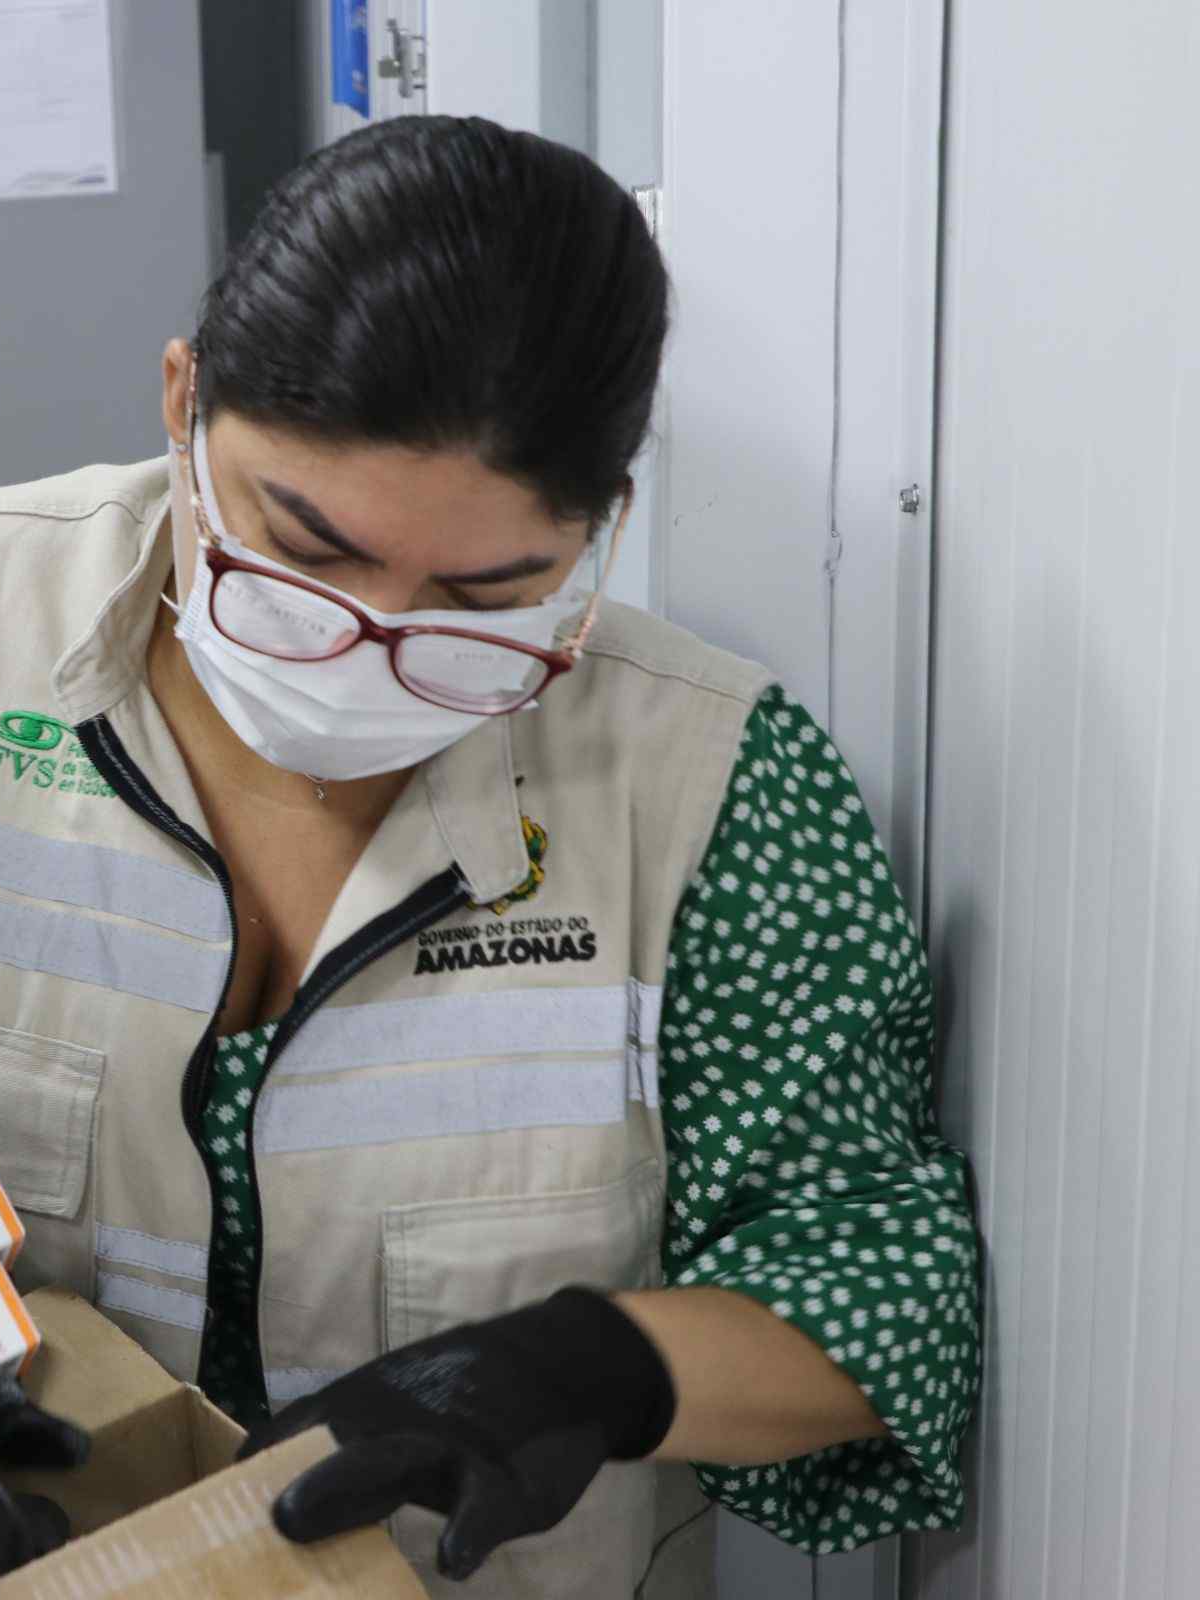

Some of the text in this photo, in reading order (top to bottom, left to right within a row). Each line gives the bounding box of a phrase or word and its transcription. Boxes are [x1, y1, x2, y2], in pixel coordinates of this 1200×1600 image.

[418, 915, 588, 947] GOVERNO DO ESTADO DO
[414, 932, 596, 975] AMAZONAS
